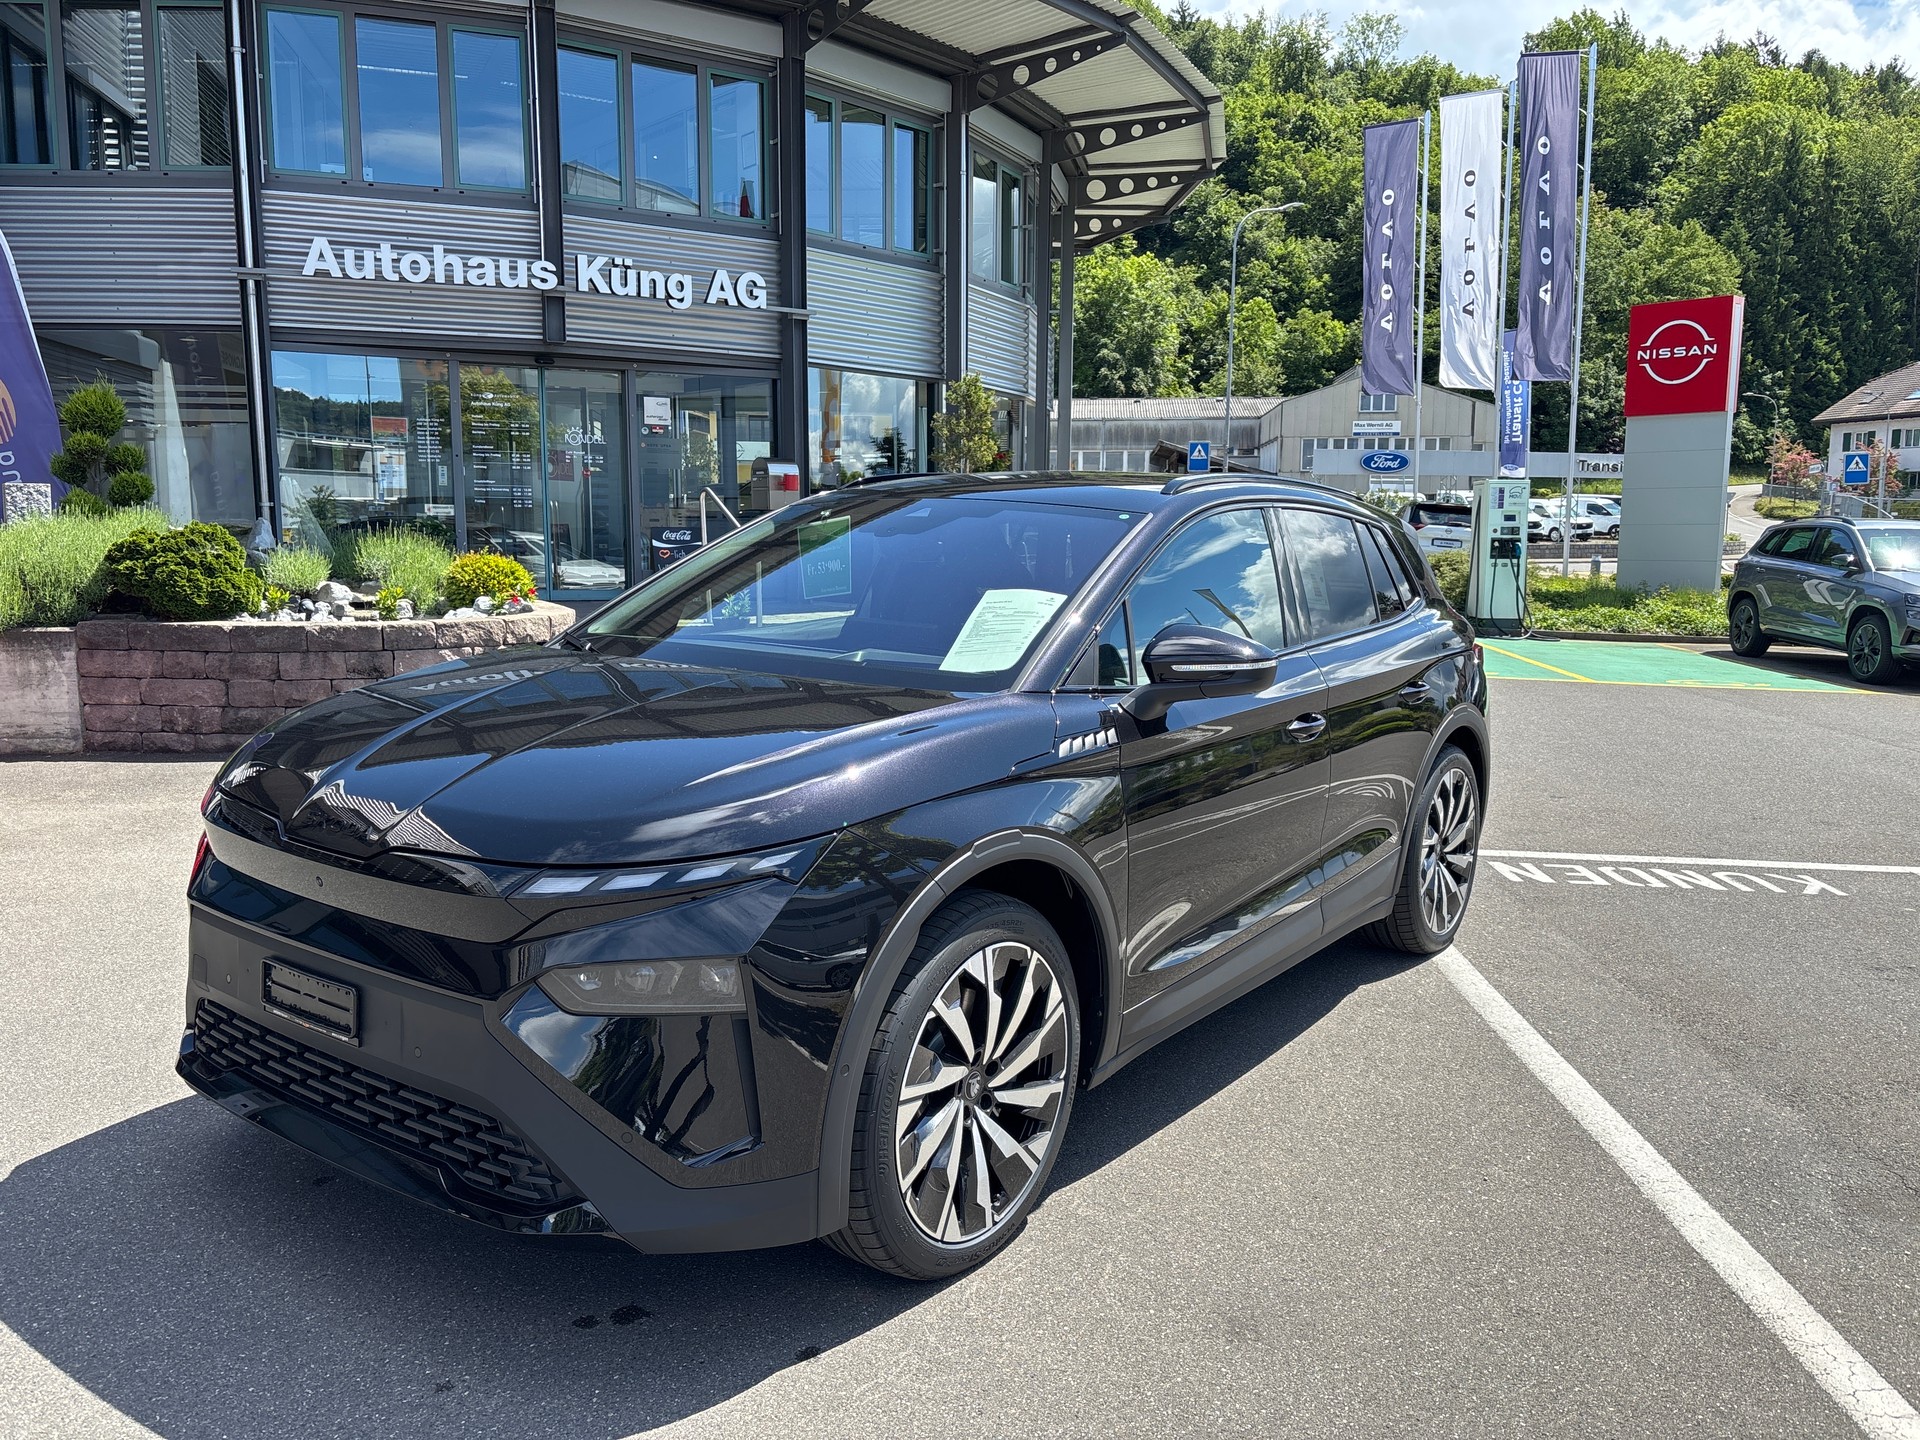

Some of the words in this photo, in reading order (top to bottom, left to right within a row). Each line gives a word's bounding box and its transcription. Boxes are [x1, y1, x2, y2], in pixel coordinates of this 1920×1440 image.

[301, 236, 559, 290] Autohaus
[576, 253, 693, 310] Küng
[705, 268, 767, 309] AG
[1637, 343, 1718, 360] NISSAN
[1370, 454, 1401, 468] Ford
[1578, 459, 1625, 473] Transi
[1487, 860, 1850, 897] KUNDEN
